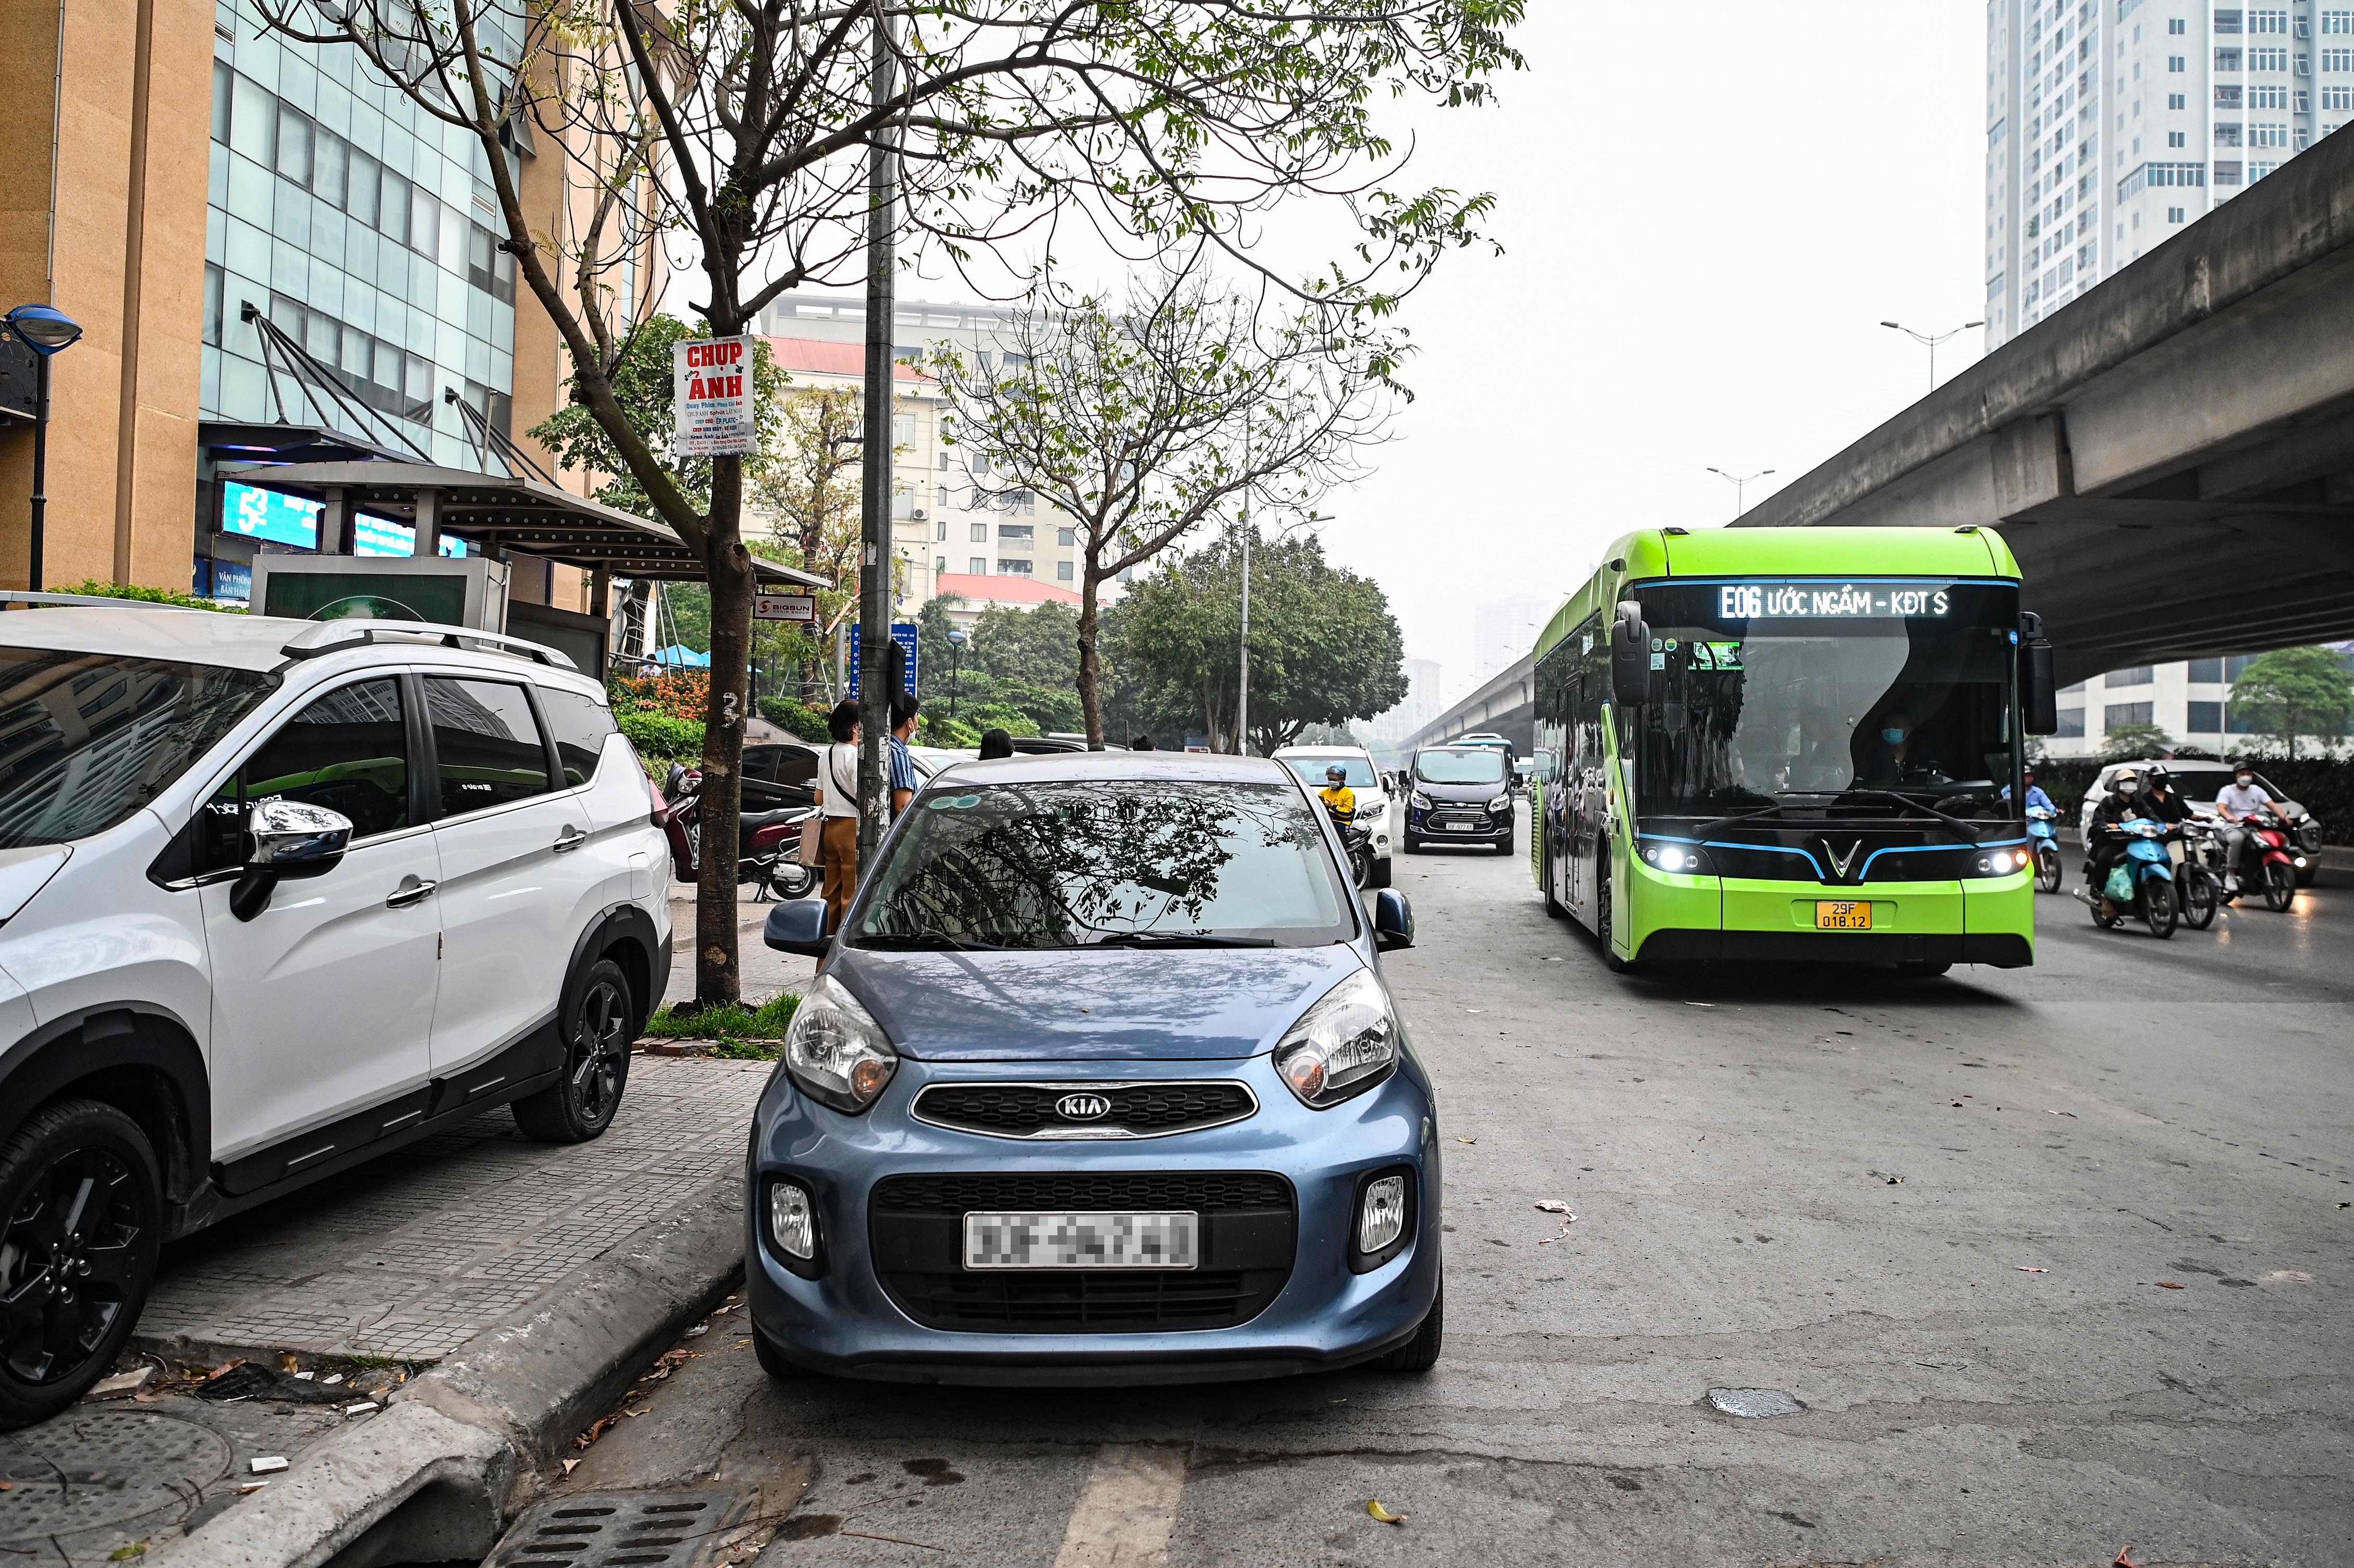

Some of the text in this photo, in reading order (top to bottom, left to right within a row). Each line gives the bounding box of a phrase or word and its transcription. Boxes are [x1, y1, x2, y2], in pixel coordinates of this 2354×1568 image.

[687, 342, 742, 371] CHỤP
[689, 370, 742, 400] ẢNH
[220, 584, 232, 594] BÁN
[1721, 586, 1761, 618] E06
[1891, 592, 1927, 615] KĐT
[1933, 591, 1948, 613] S
[1832, 903, 1855, 914] 29F
[1823, 916, 1865, 927] 018.12
[1065, 1098, 1102, 1115] KIA
